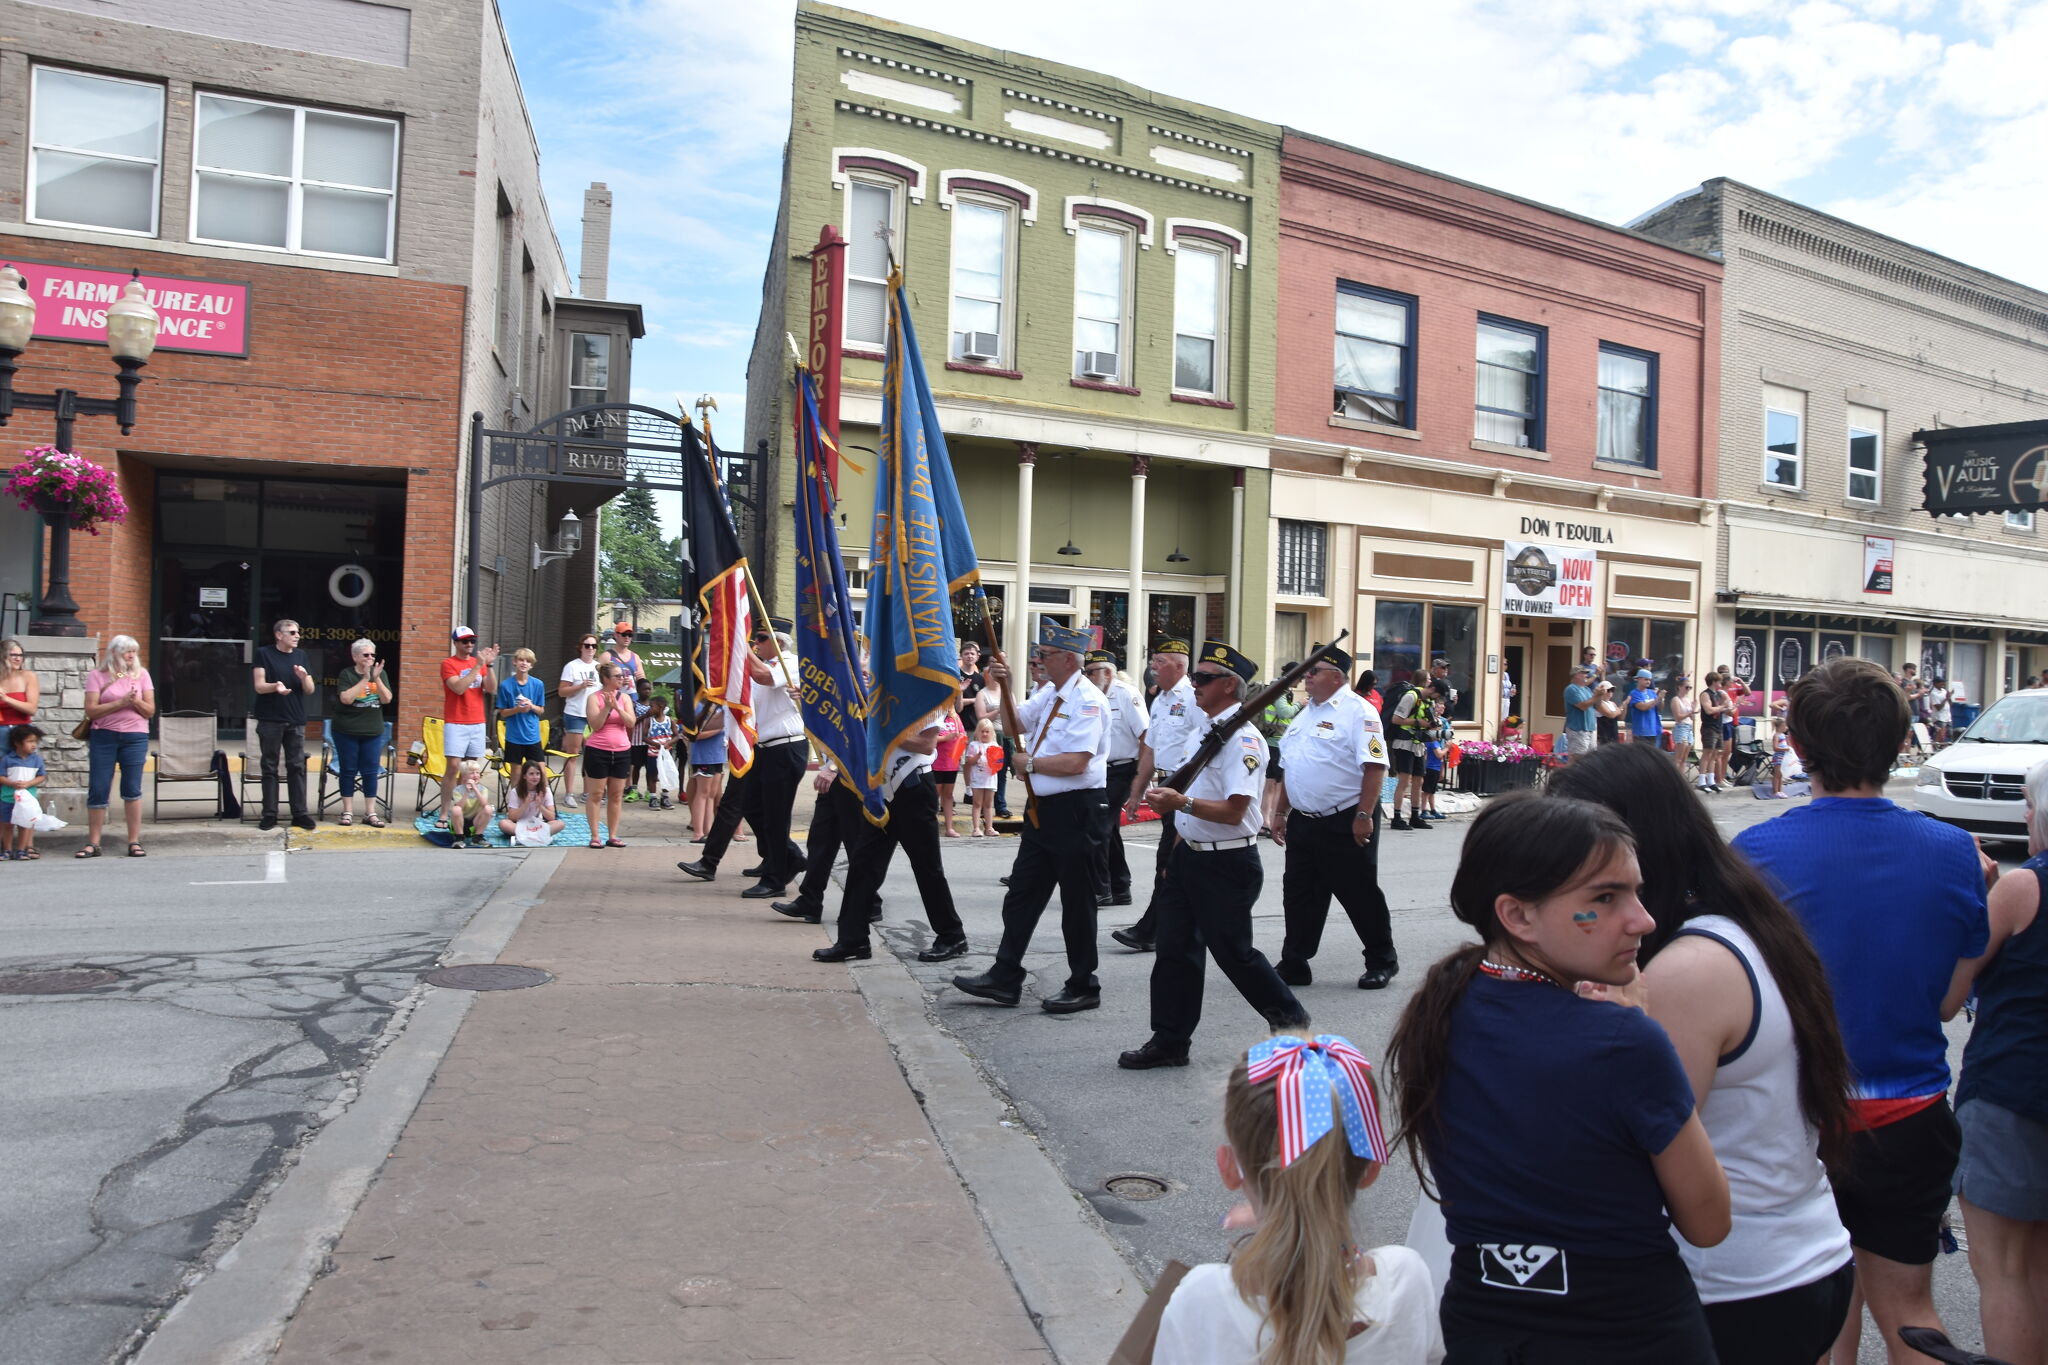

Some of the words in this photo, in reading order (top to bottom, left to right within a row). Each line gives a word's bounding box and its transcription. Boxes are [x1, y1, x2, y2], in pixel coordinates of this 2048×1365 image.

[43, 278, 119, 304] FARM
[145, 288, 233, 315] UREAU
[61, 306, 214, 339] INSANCE
[811, 253, 829, 400] EMPOR
[1962, 456, 1997, 468] MUSIC
[1936, 464, 2000, 502] VAULT
[1520, 516, 1550, 537] DON
[1555, 521, 1614, 544] TEQUILA
[909, 509, 945, 647] MANISTEE
[1562, 558, 1592, 581] NOW
[1504, 598, 1523, 612] NEW
[1525, 600, 1553, 614] OWNER
[1559, 583, 1592, 607] OPEN
[800, 657, 842, 701] FOREI
